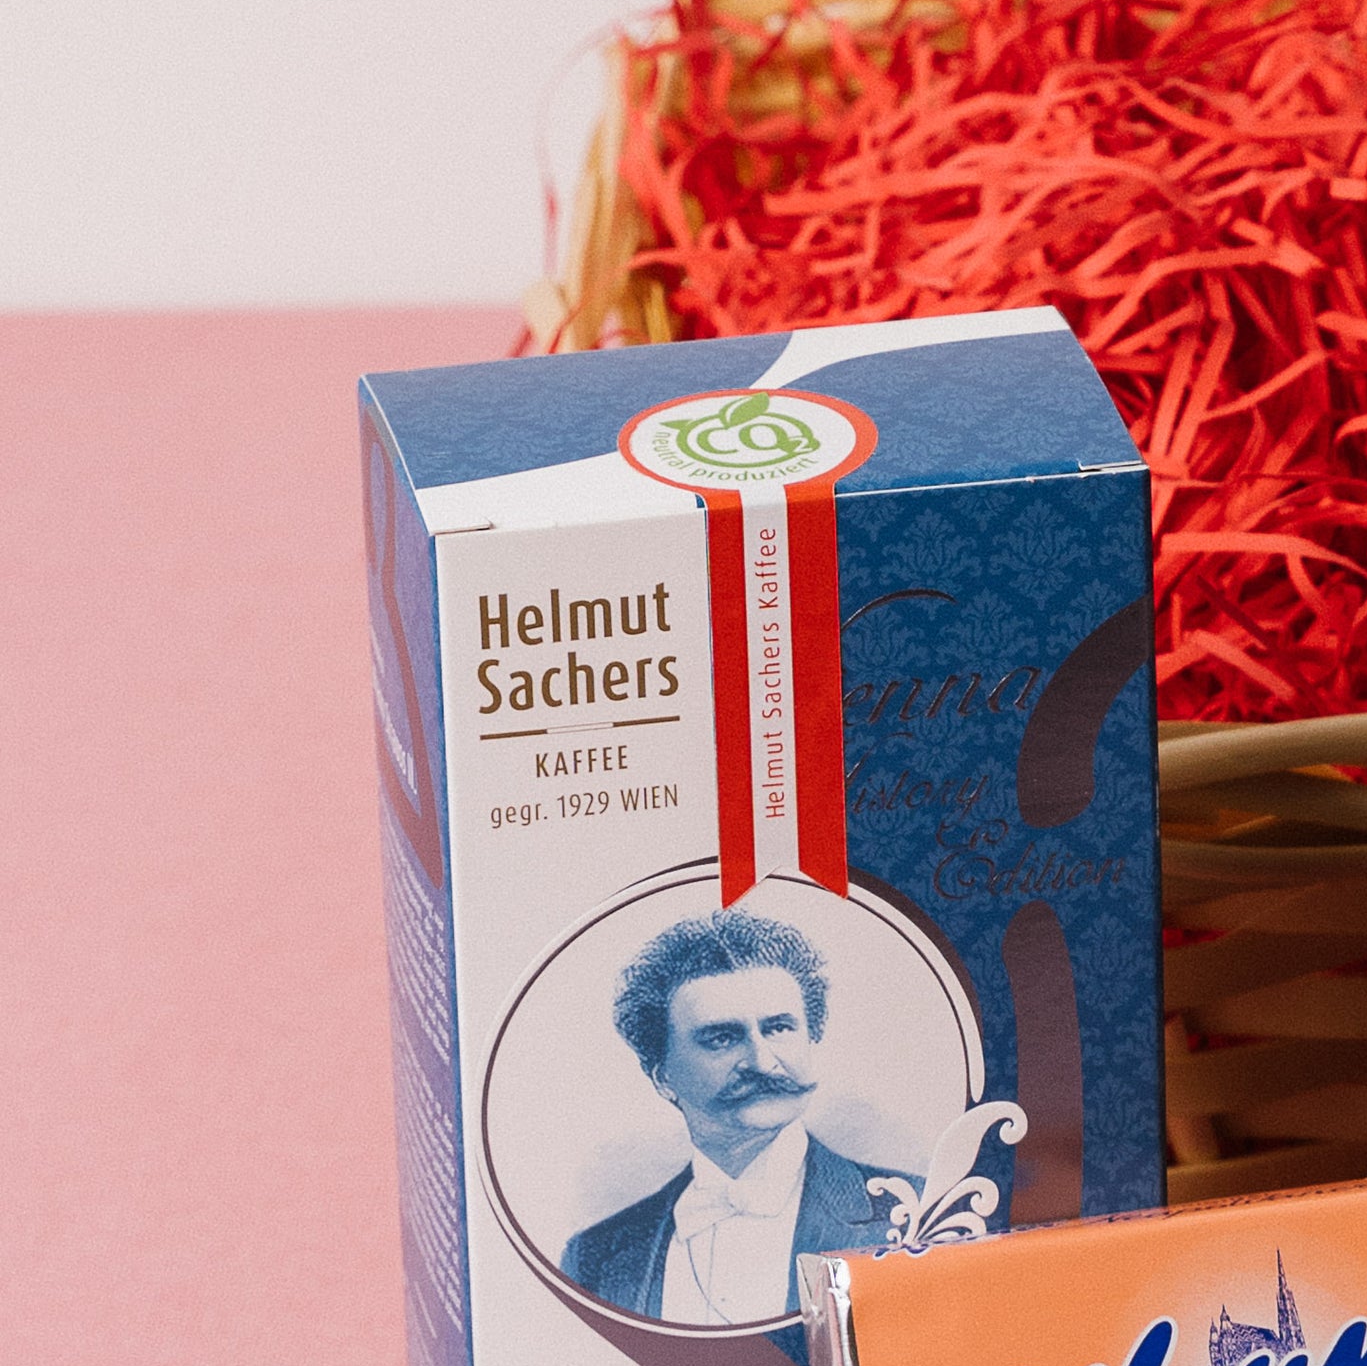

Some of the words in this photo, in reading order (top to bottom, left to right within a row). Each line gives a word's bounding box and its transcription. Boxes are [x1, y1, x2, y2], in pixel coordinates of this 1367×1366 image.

[652, 431, 692, 471] neutral
[688, 455, 820, 482] produziert
[756, 525, 779, 610] Kaffee
[478, 581, 672, 651] Helmut
[478, 653, 680, 716] Sachers
[760, 621, 784, 719] Sachers
[534, 744, 630, 781] KAFFEE
[763, 727, 787, 820] Helmut
[489, 796, 550, 830] gegr.
[556, 790, 610, 821] 1929
[619, 782, 681, 815] WIEN
